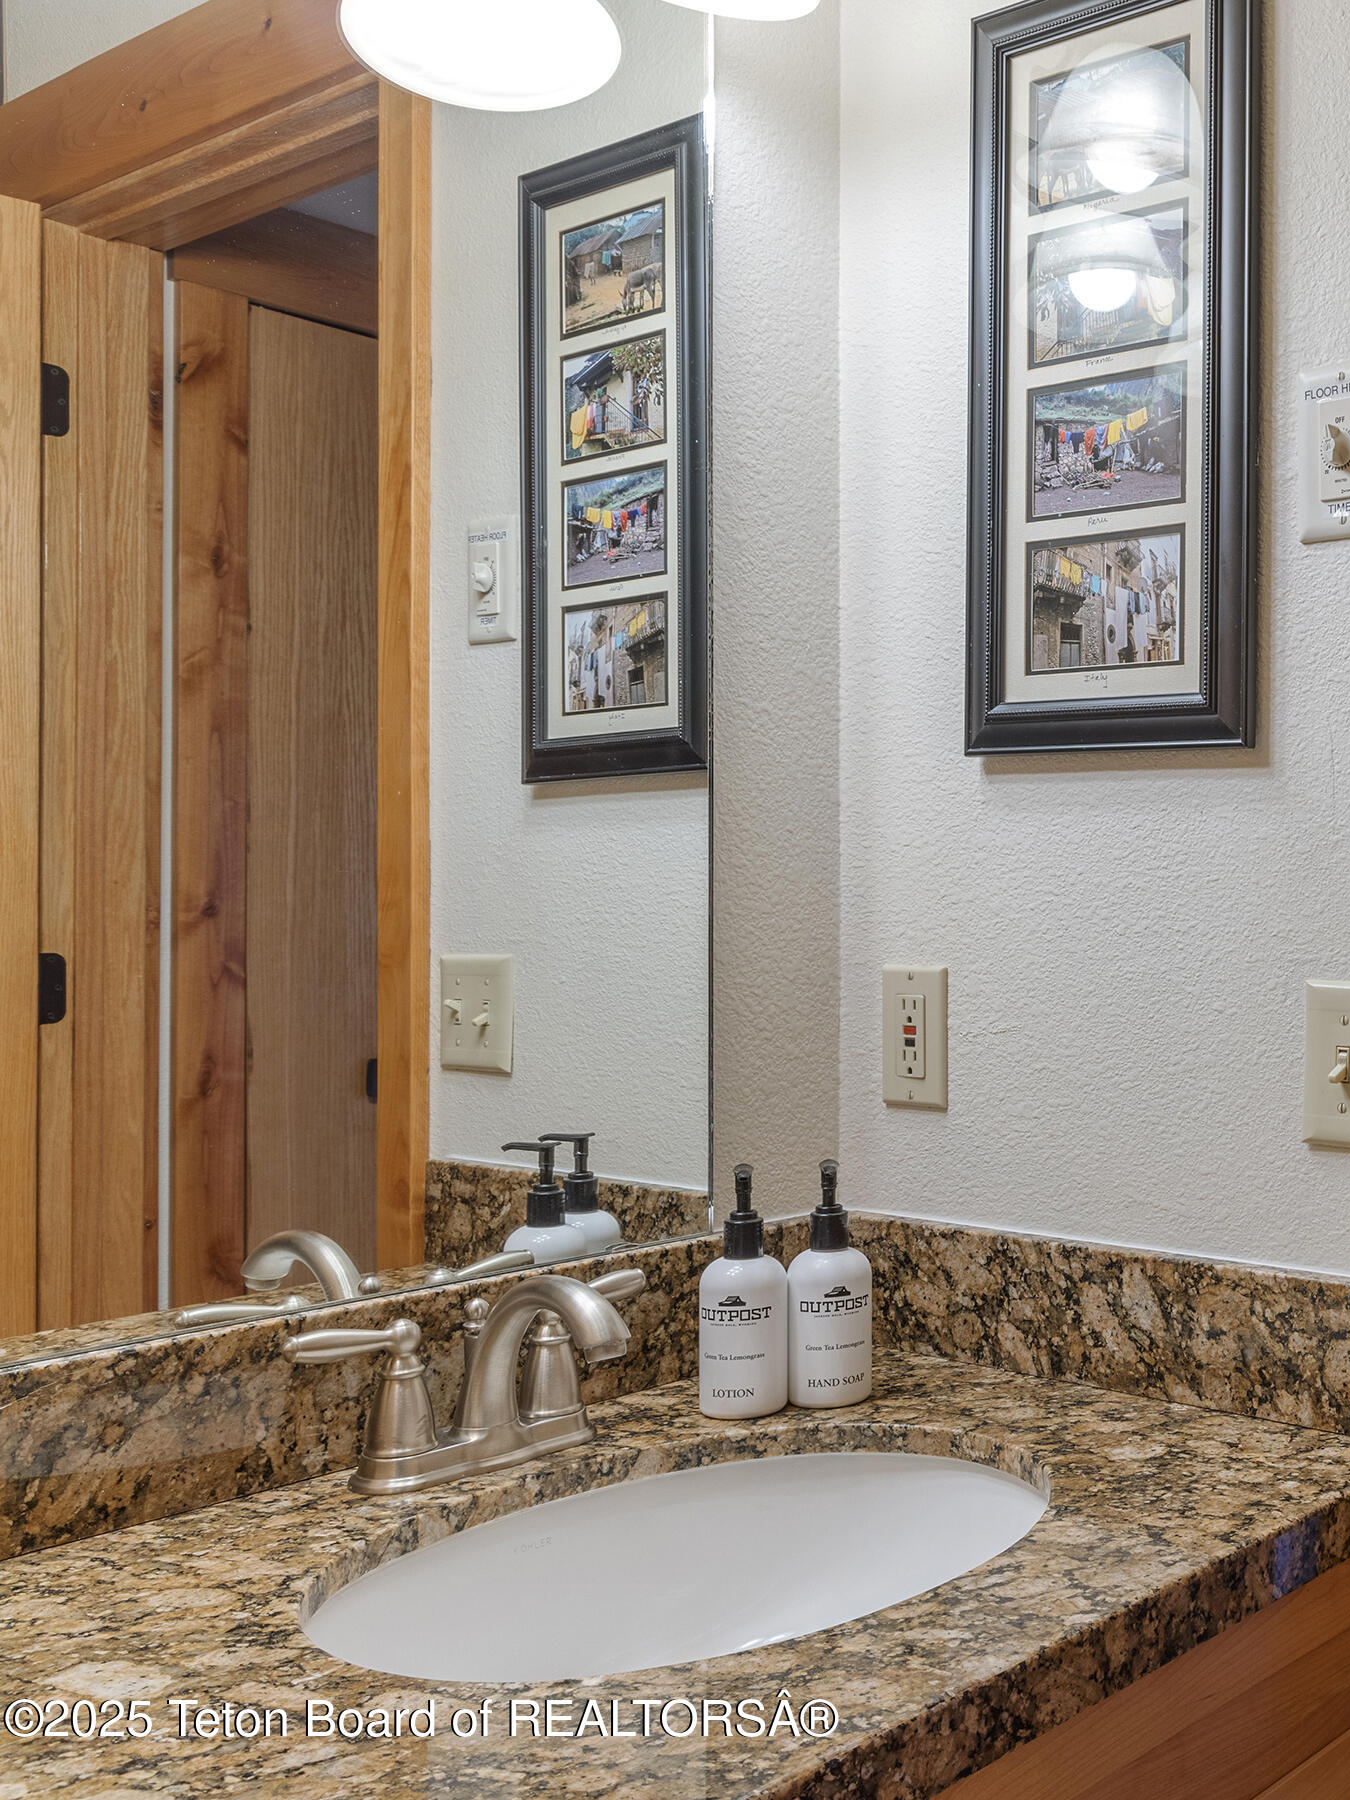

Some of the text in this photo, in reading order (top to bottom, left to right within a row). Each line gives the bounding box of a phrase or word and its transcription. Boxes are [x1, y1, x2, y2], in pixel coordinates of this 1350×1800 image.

[1304, 386, 1339, 400] FLOOR
[800, 1294, 869, 1313] OUTPOST
[701, 1306, 771, 1321] OUTPOST
[808, 1372, 865, 1388] HAND SOAP
[712, 1388, 755, 1398] LOTION
